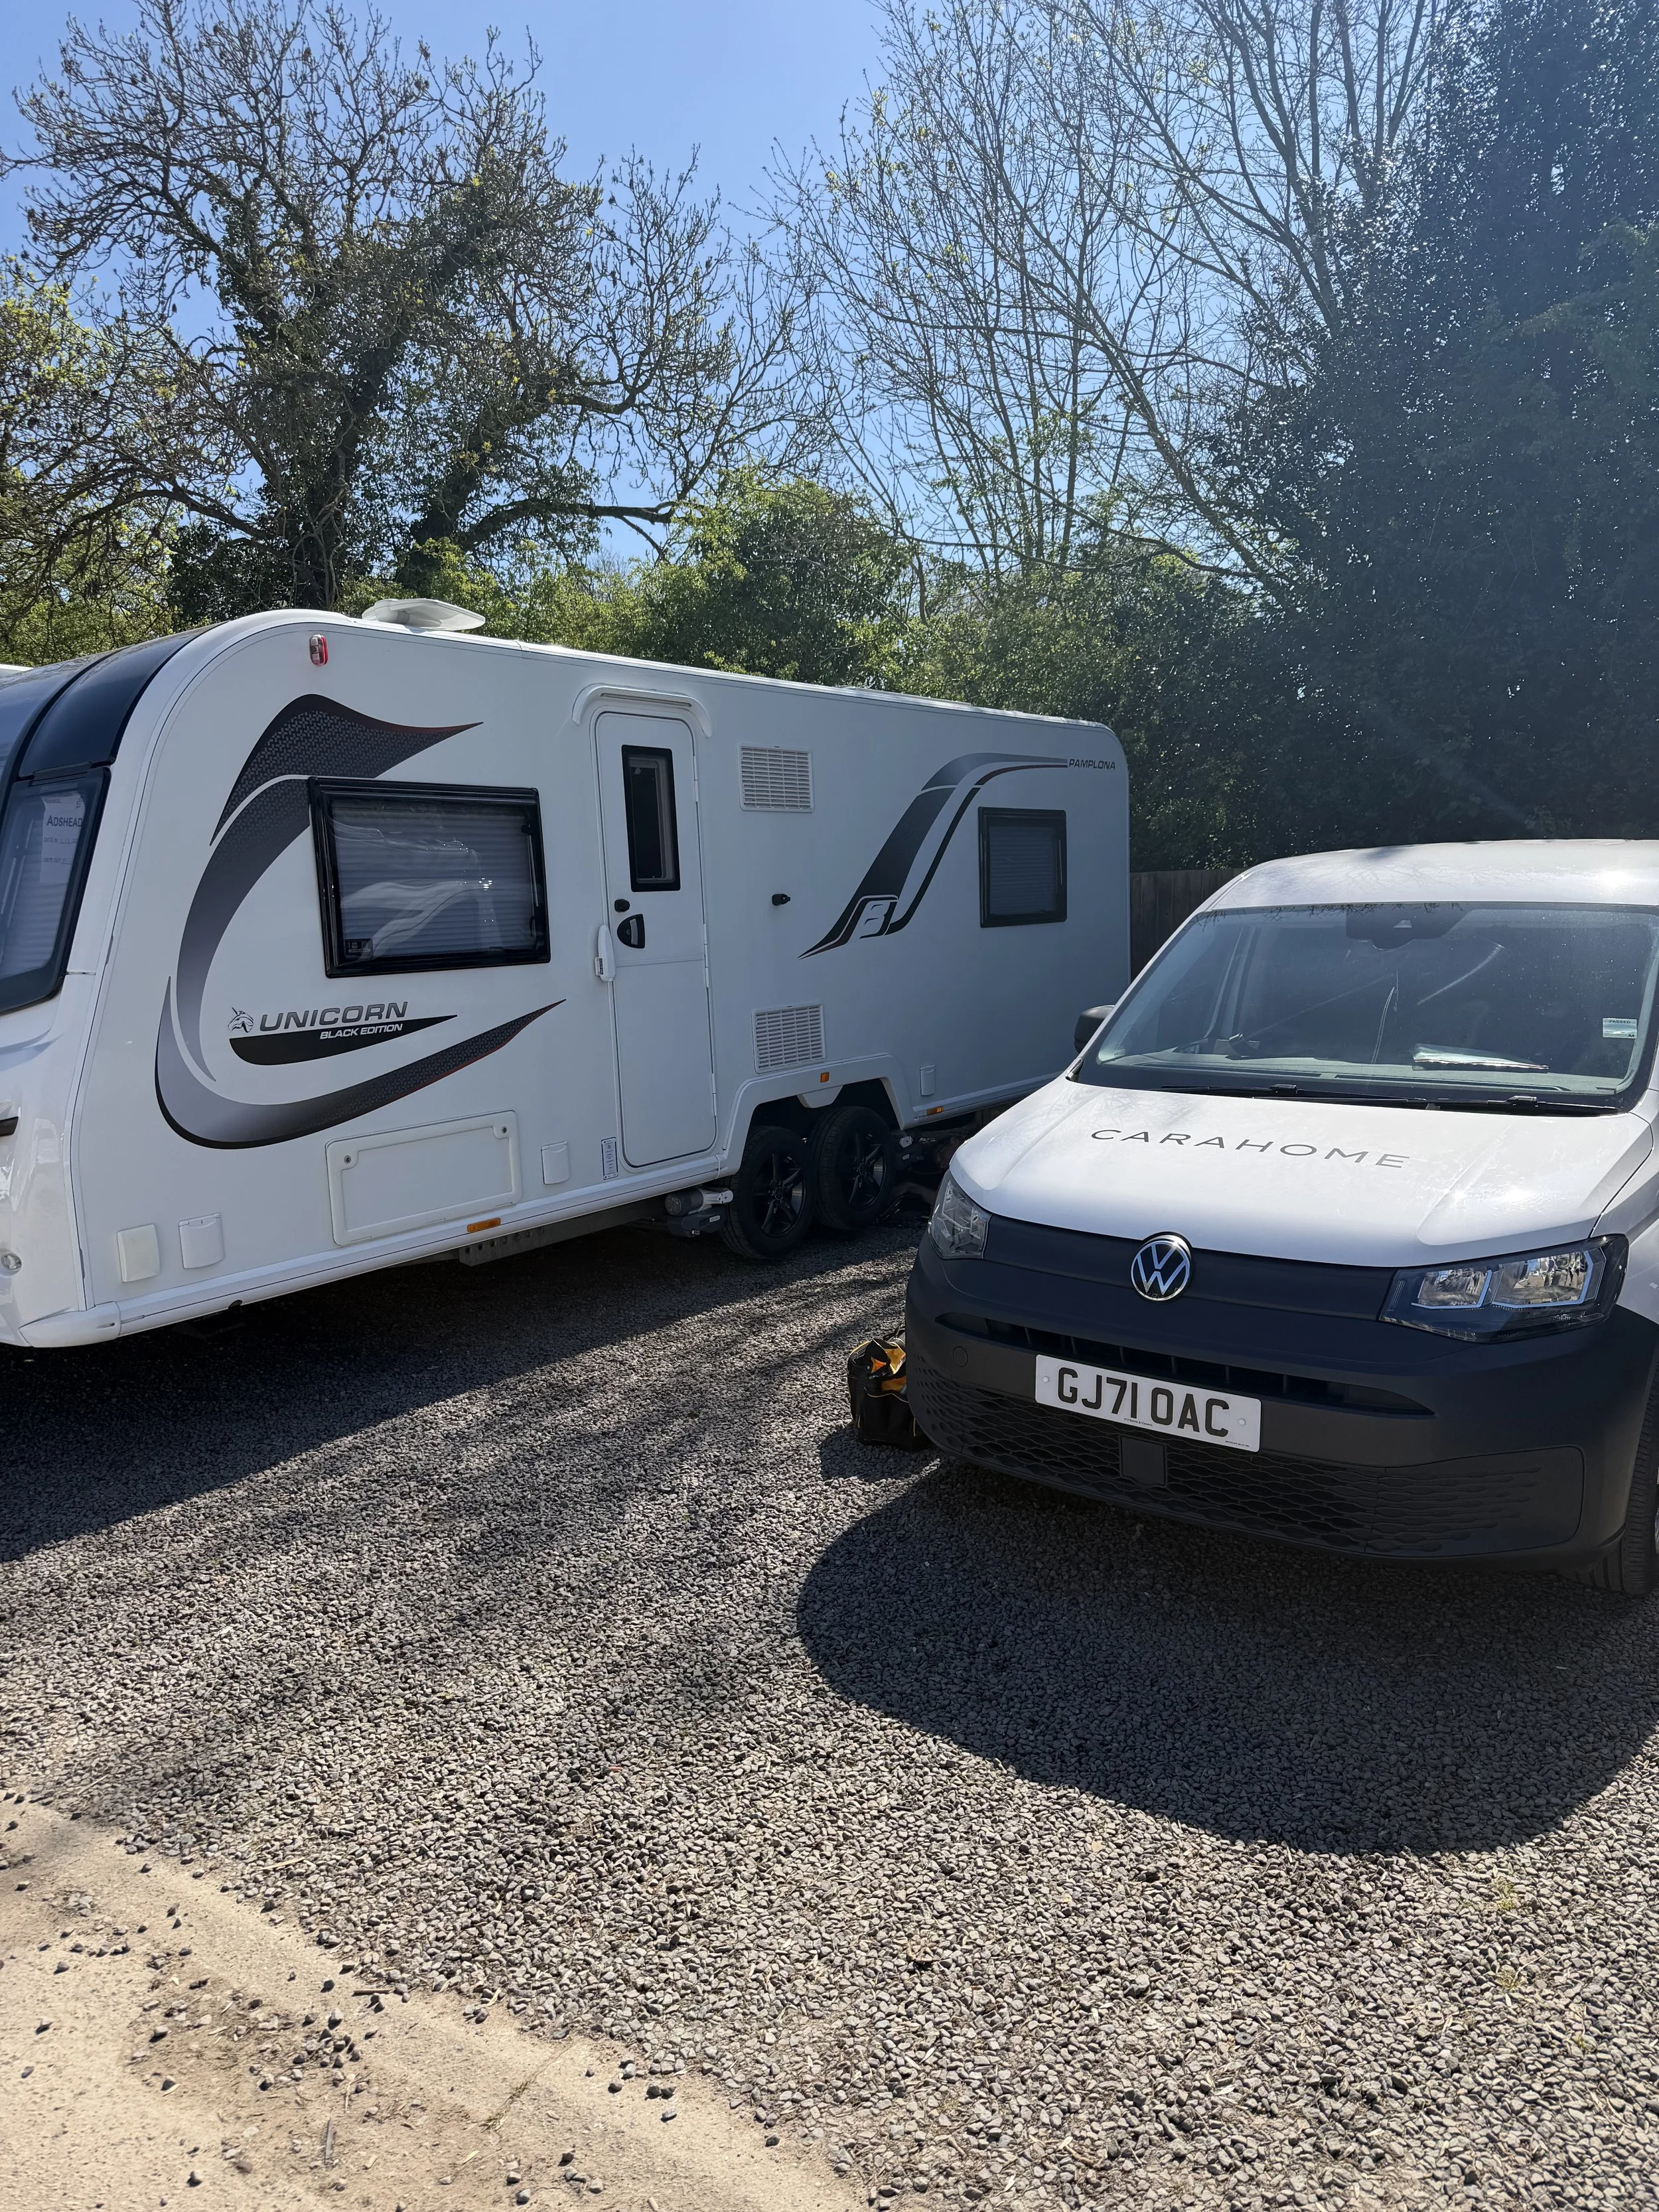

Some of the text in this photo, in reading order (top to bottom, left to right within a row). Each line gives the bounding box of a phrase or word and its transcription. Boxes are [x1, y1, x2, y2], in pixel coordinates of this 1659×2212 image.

[1068, 759, 1116, 770] PAMPLONA
[46, 815, 83, 827] ADSHEAD
[259, 1001, 408, 1031] UNICORN
[319, 1023, 403, 1040] BLACK EDITION
[1091, 1129, 1411, 1169] CARAHOME
[1058, 1366, 1230, 1438] GJ71 OAC
